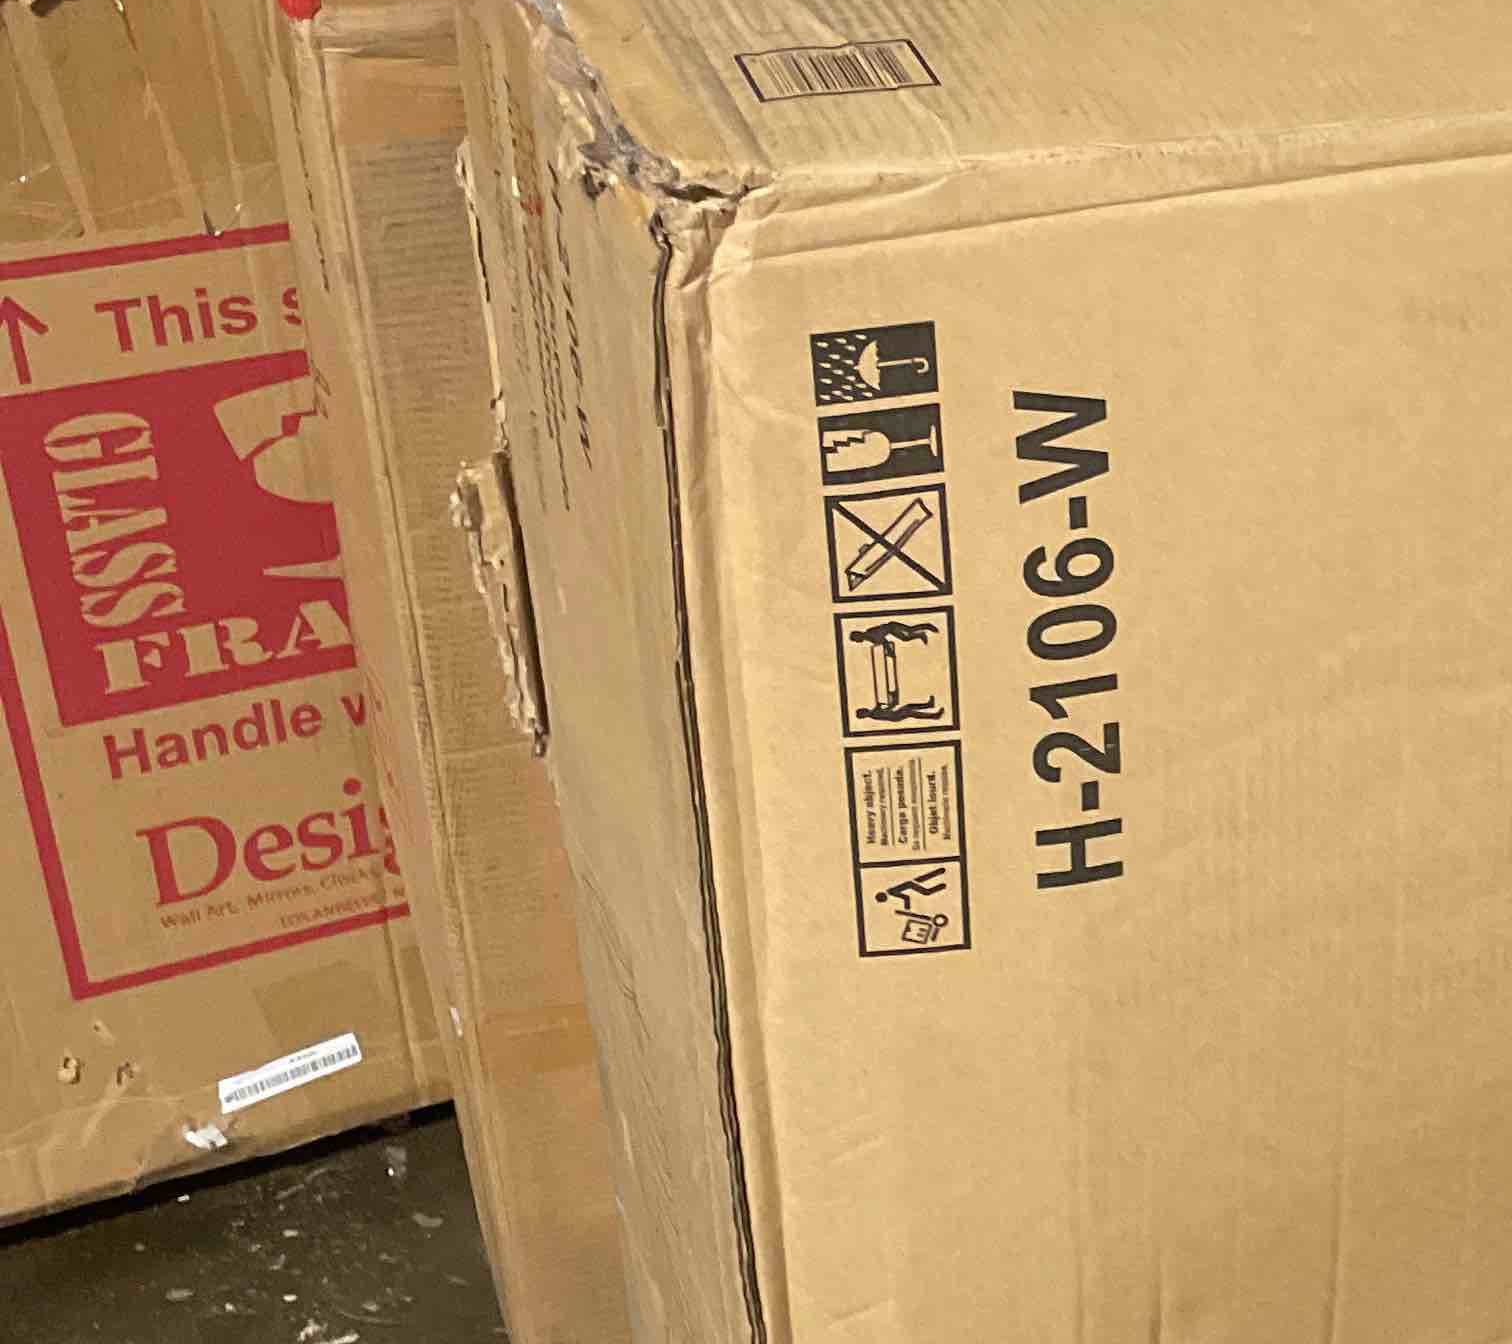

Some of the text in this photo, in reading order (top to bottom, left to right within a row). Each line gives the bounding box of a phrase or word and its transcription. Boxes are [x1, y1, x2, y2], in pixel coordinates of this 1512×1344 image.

[95, 289, 257, 353] This
[44, 412, 186, 627] GLASS
[97, 600, 351, 695] FRA
[1012, 390, 1124, 889] H-2106-W
[103, 698, 321, 778] Handle
[862, 770, 876, 844] Heavy object.
[894, 767, 908, 844] Carga pesada.
[927, 771, 940, 834] Objet lourd.
